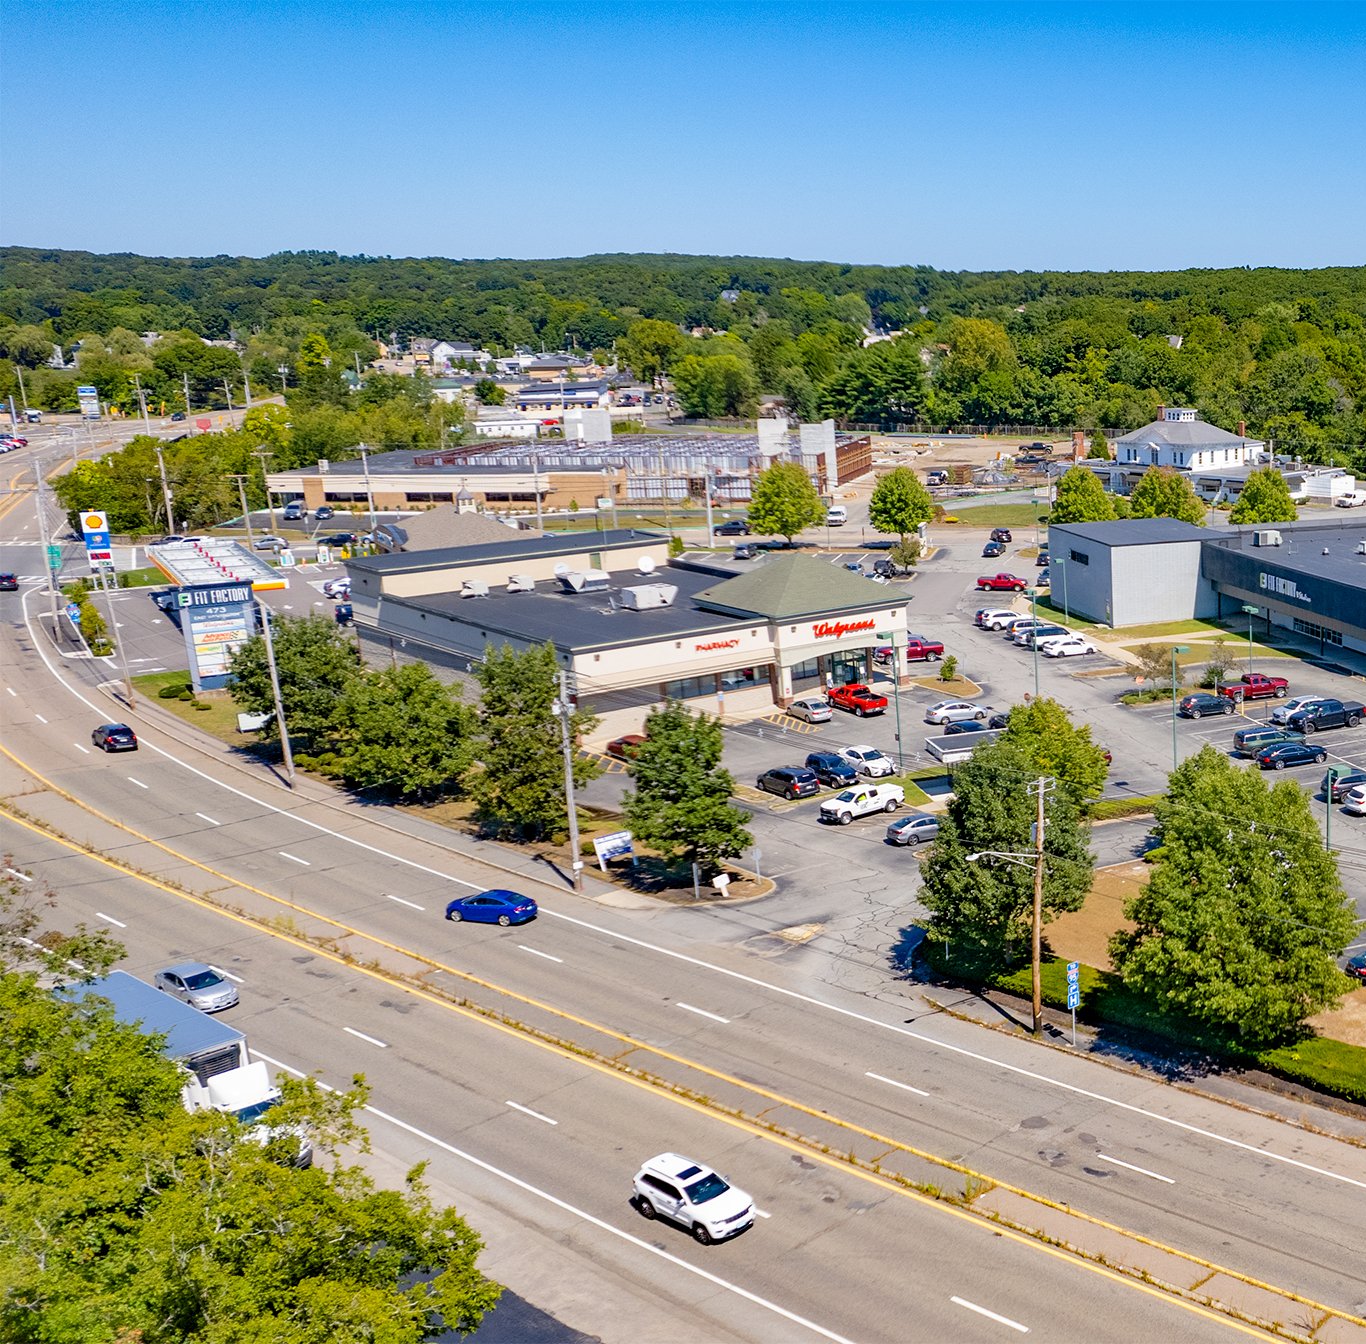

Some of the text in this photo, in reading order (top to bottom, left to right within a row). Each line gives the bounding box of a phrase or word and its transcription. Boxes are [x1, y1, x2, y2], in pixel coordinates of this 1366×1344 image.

[194, 588, 249, 605] FIT FACTORY
[812, 618, 876, 639] Walgreens
[695, 639, 740, 652] PHARMACY
